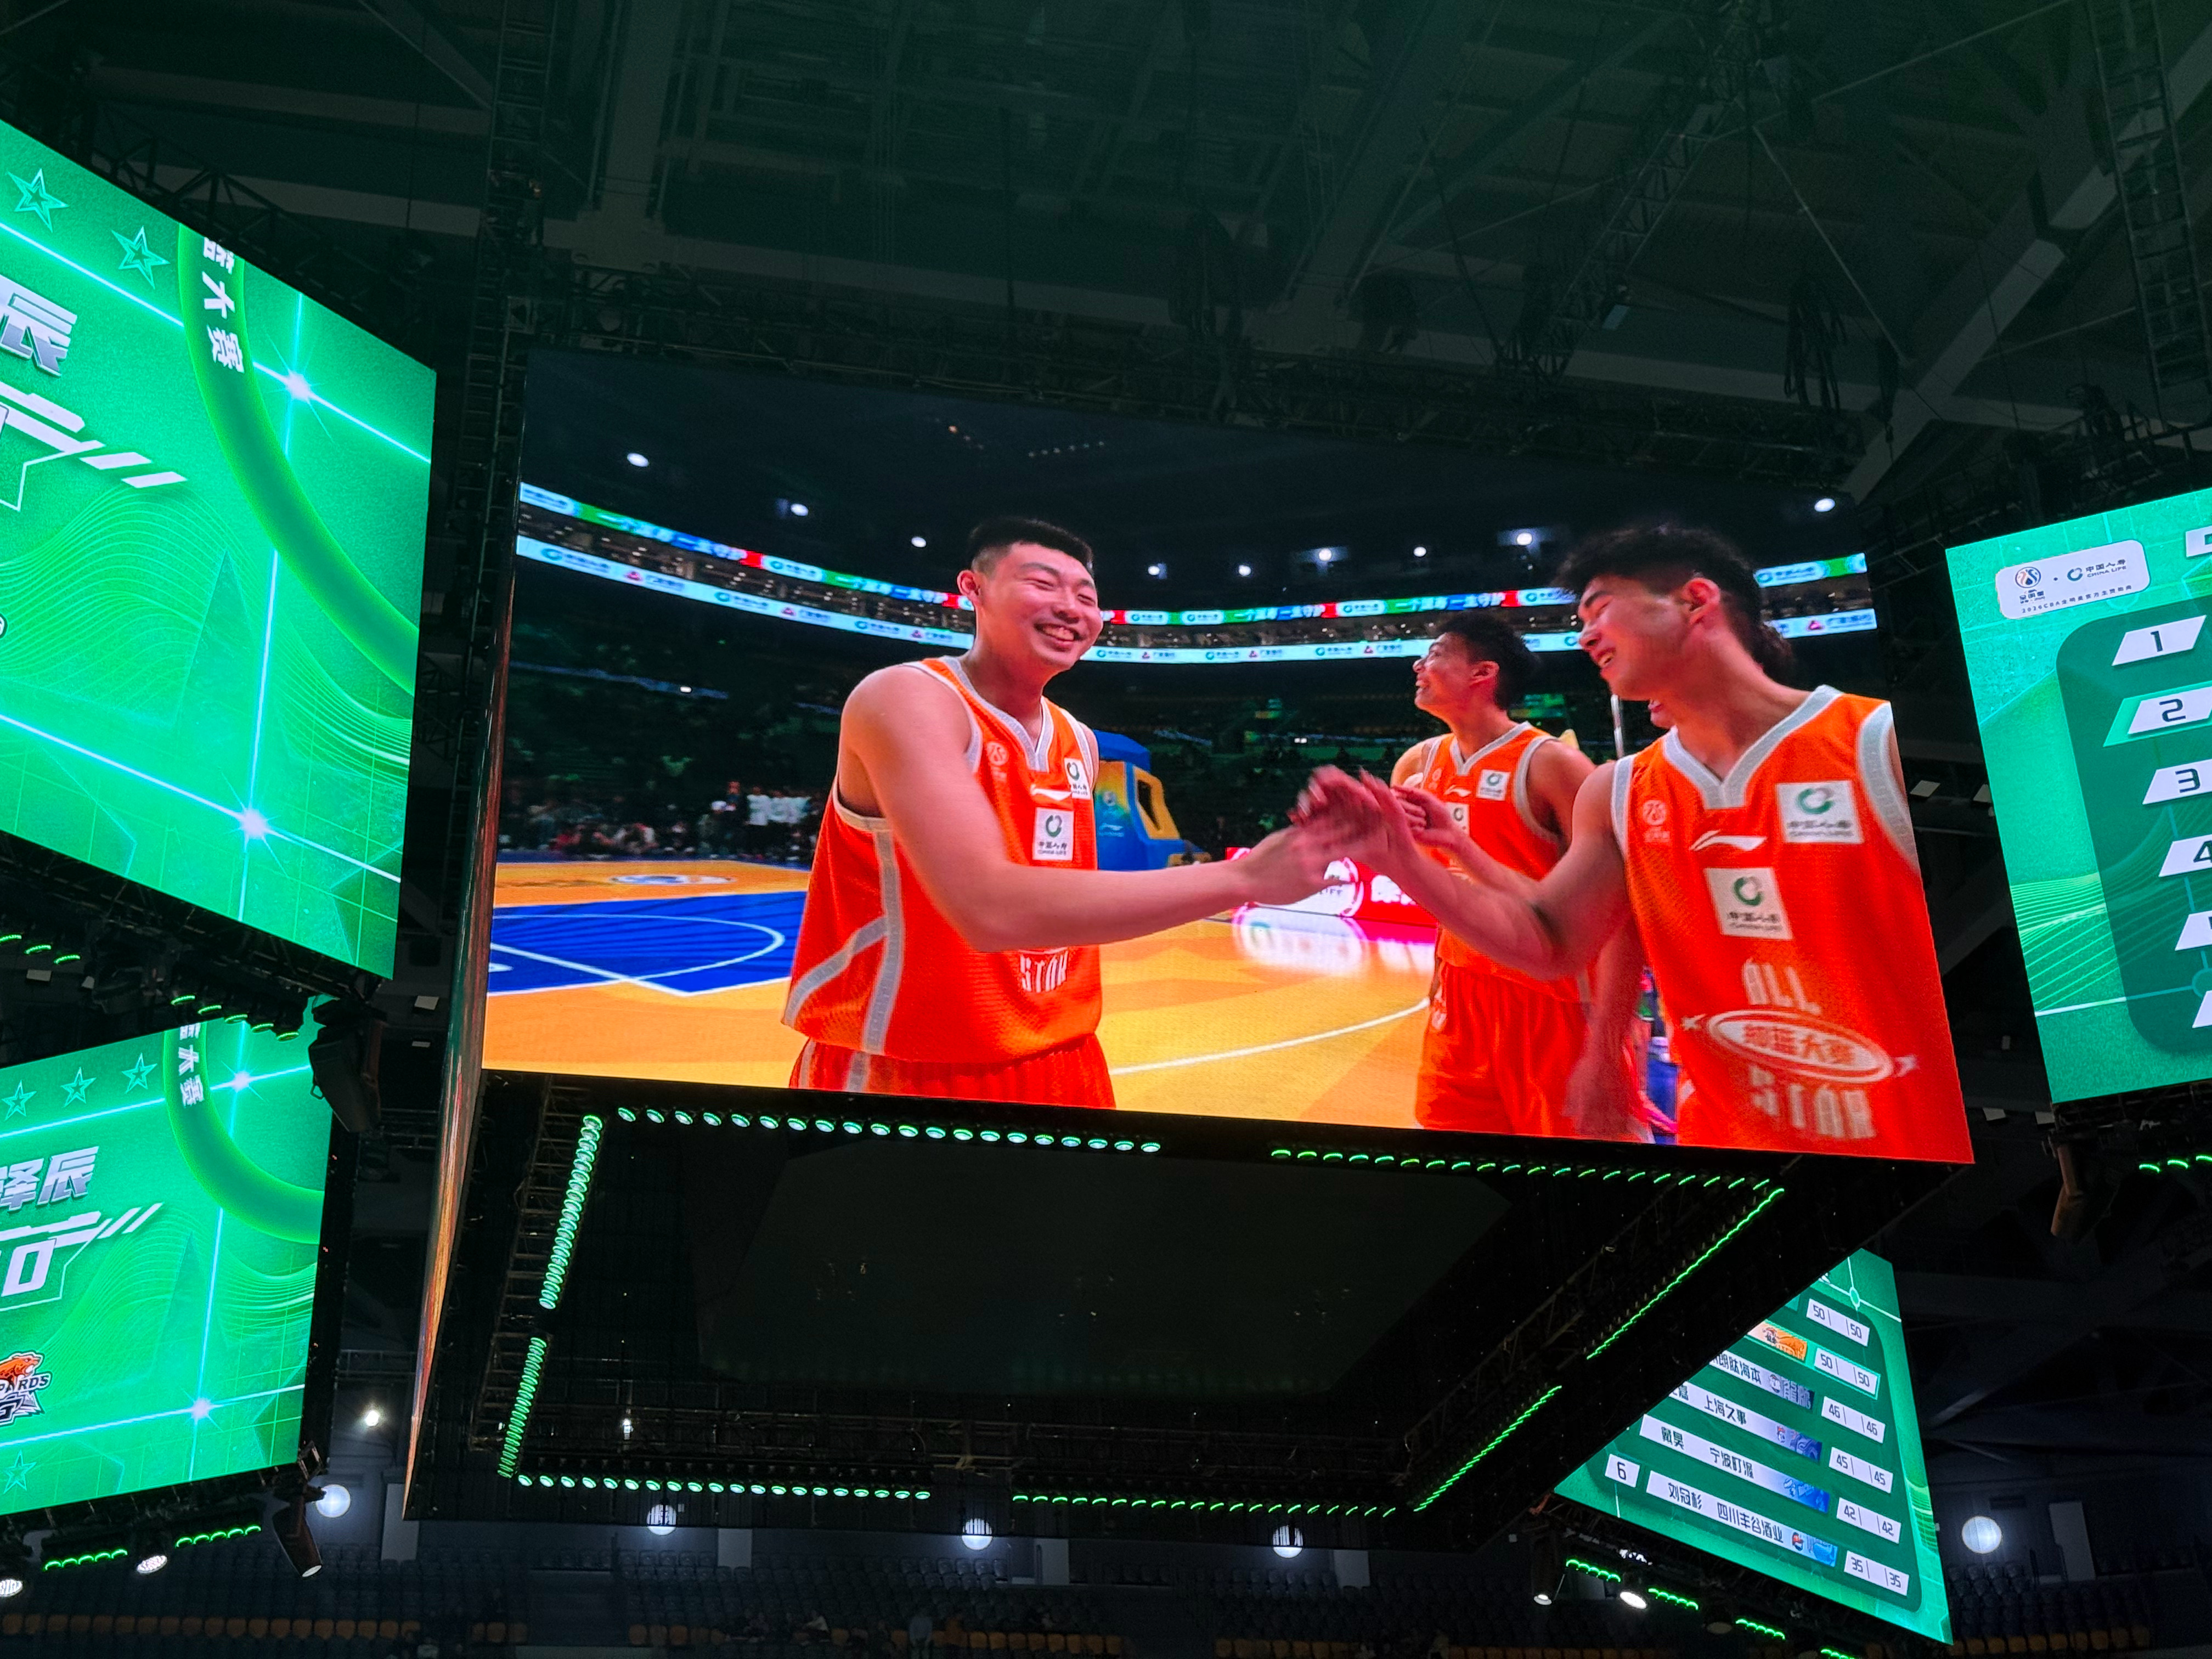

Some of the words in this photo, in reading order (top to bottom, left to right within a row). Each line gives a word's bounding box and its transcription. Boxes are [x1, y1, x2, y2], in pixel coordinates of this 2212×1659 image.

[2150, 631, 2163, 652] 1
[2159, 698, 2186, 722] 2
[2175, 768, 2201, 793] 3
[1813, 1304, 1826, 1321] 50
[1850, 1323, 1863, 1339] 50
[1820, 1353, 1833, 1369] 50
[1858, 1371, 1870, 1387] 50
[1829, 1403, 1841, 1419] 46
[1866, 1421, 1878, 1436] 46
[1836, 1454, 1848, 1470] 45
[1874, 1471, 1886, 1486] 45
[1617, 1462, 1627, 1480] 6
[1717, 1502, 1784, 1543] 四川丰谷酒业
[1844, 1504, 1857, 1521] 42
[1882, 1520, 1894, 1537] 42
[1850, 1556, 1863, 1573] 35
[1889, 1572, 1901, 1588] 35
